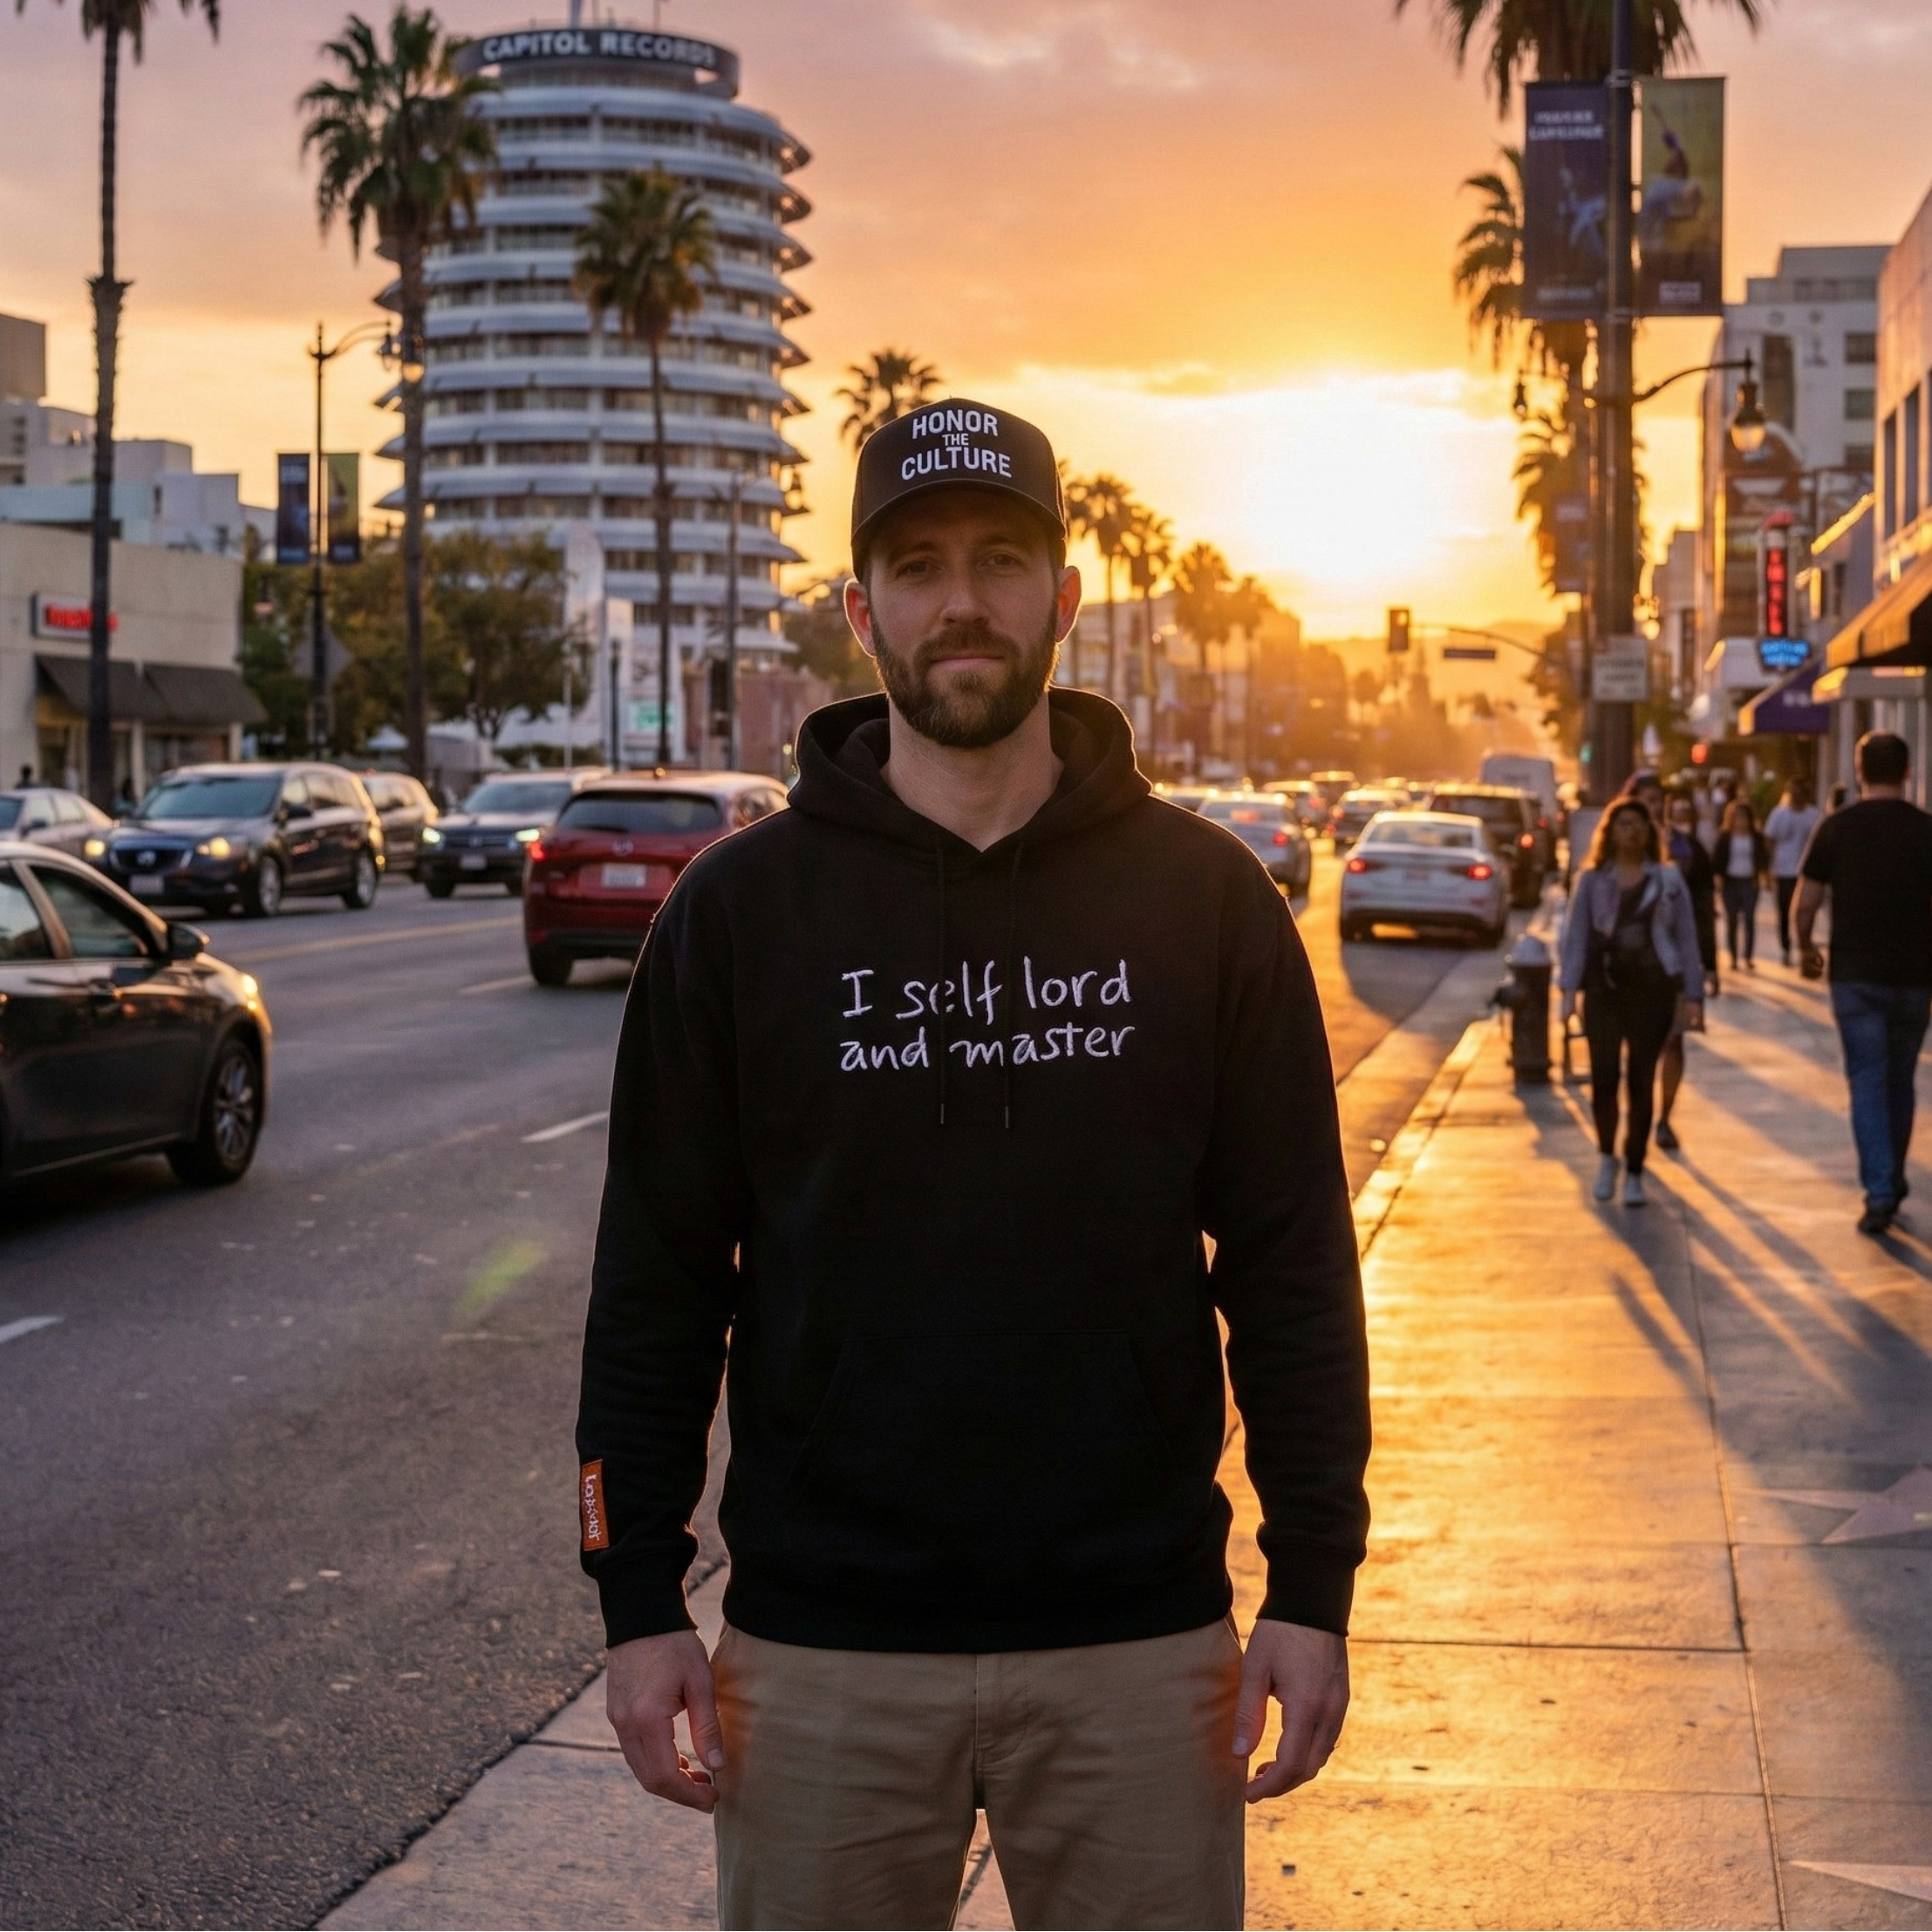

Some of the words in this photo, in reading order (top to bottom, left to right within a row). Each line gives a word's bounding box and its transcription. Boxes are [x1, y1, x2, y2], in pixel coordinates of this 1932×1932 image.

[482, 31, 592, 61] CAPITOL
[912, 409, 999, 440] HONOR
[942, 434, 969, 446] THE
[901, 447, 1012, 481] CULTURE
[841, 969, 874, 1017] I
[896, 960, 1003, 1026] self
[1023, 955, 1130, 1009] lord
[840, 1027, 929, 1071] and
[949, 1022, 1136, 1067] master
